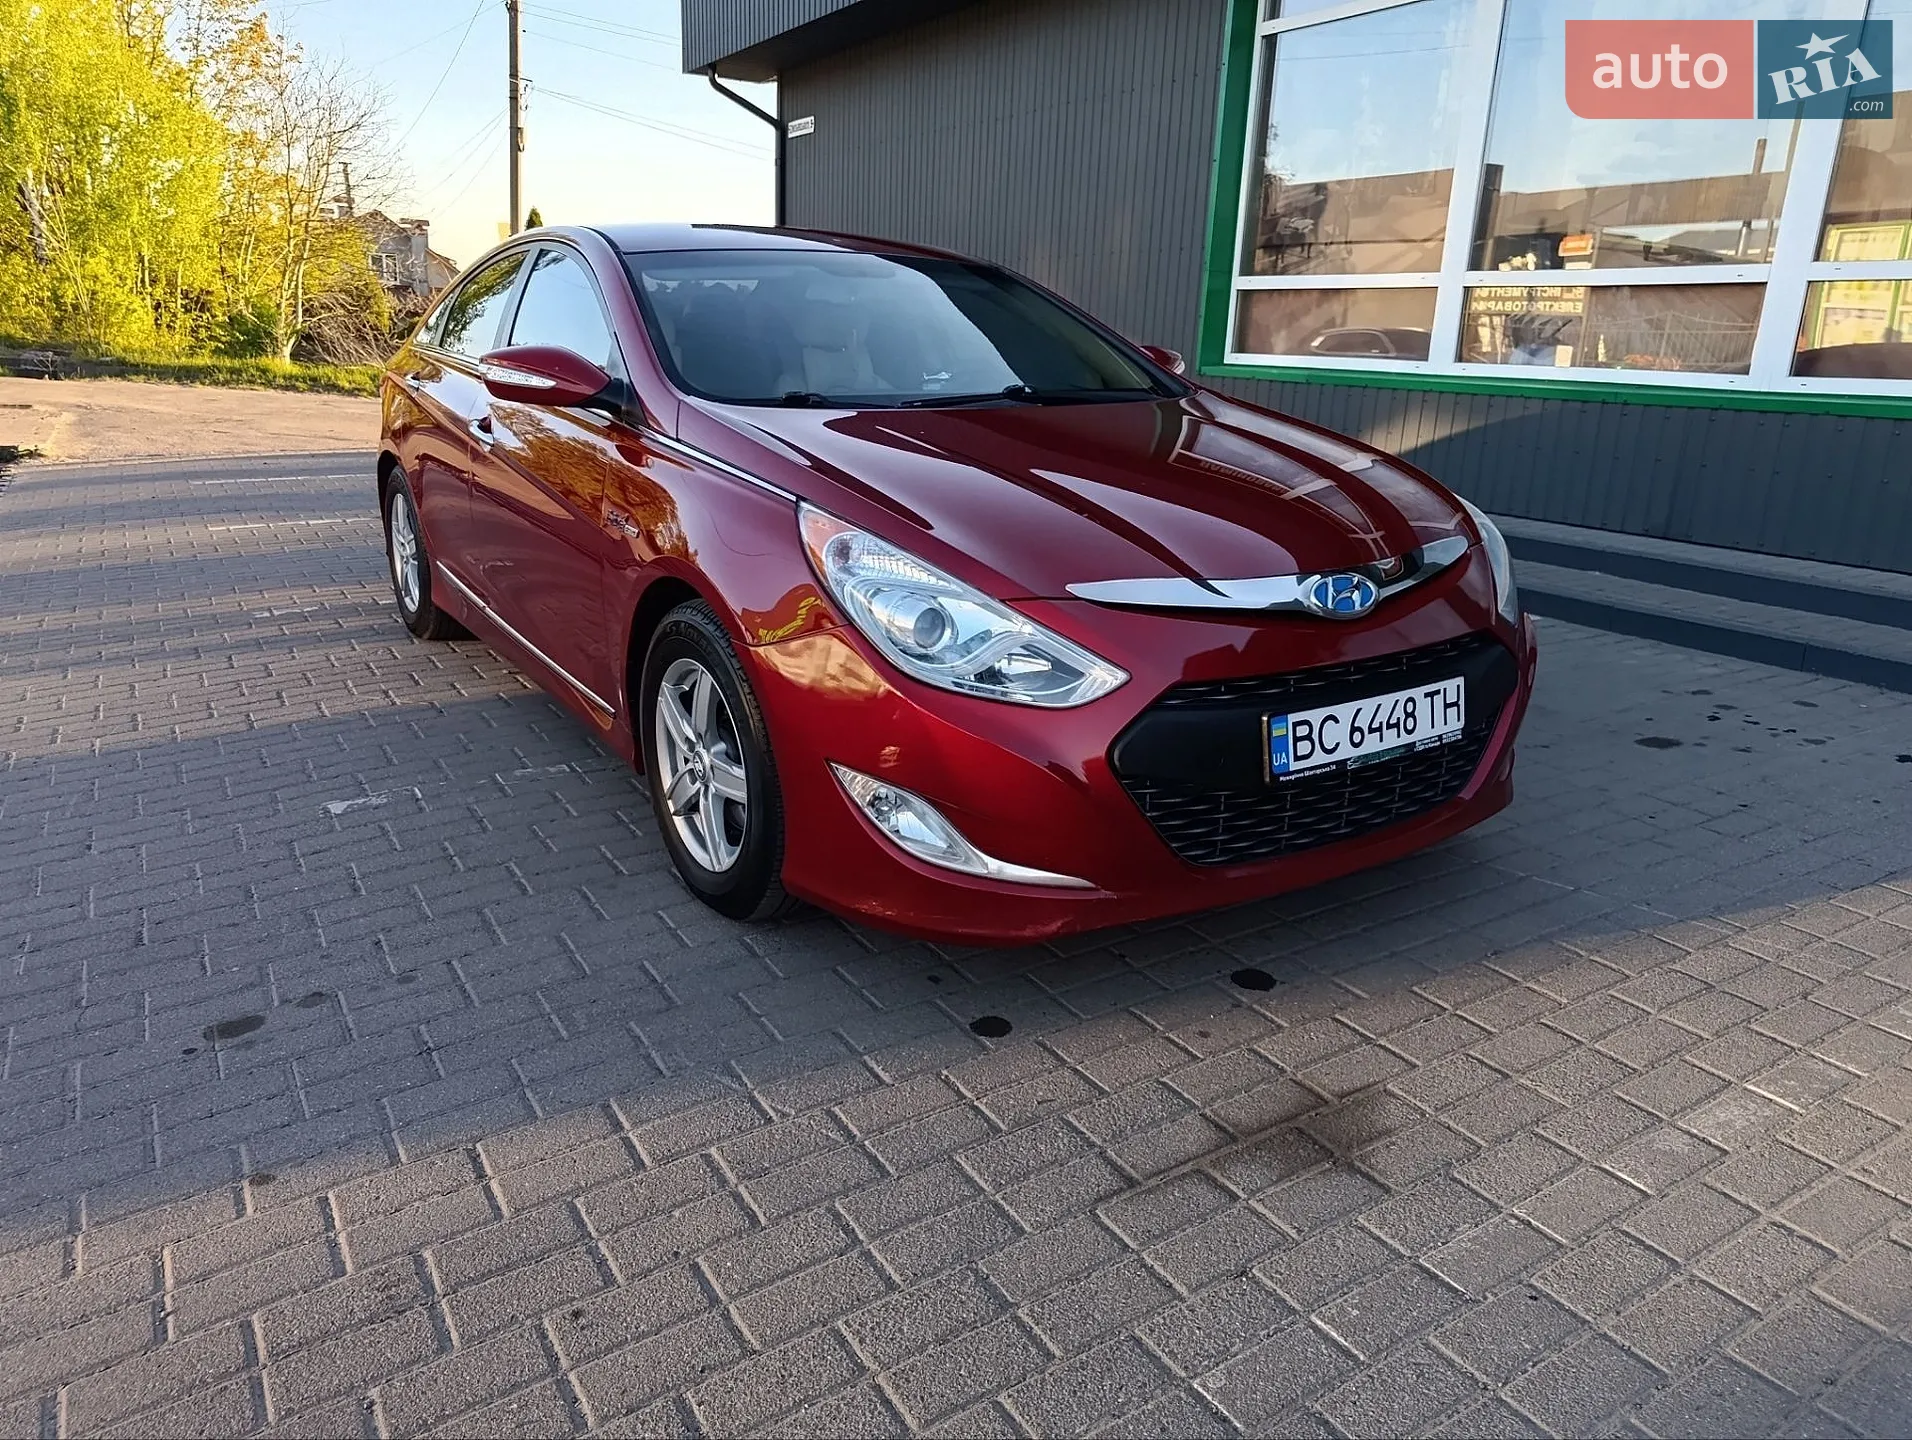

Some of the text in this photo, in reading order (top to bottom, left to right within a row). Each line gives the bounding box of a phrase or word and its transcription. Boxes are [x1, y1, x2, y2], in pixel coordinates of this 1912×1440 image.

[1291, 684, 1462, 763] BC 6448 TH
[1273, 752, 1288, 766] UA
